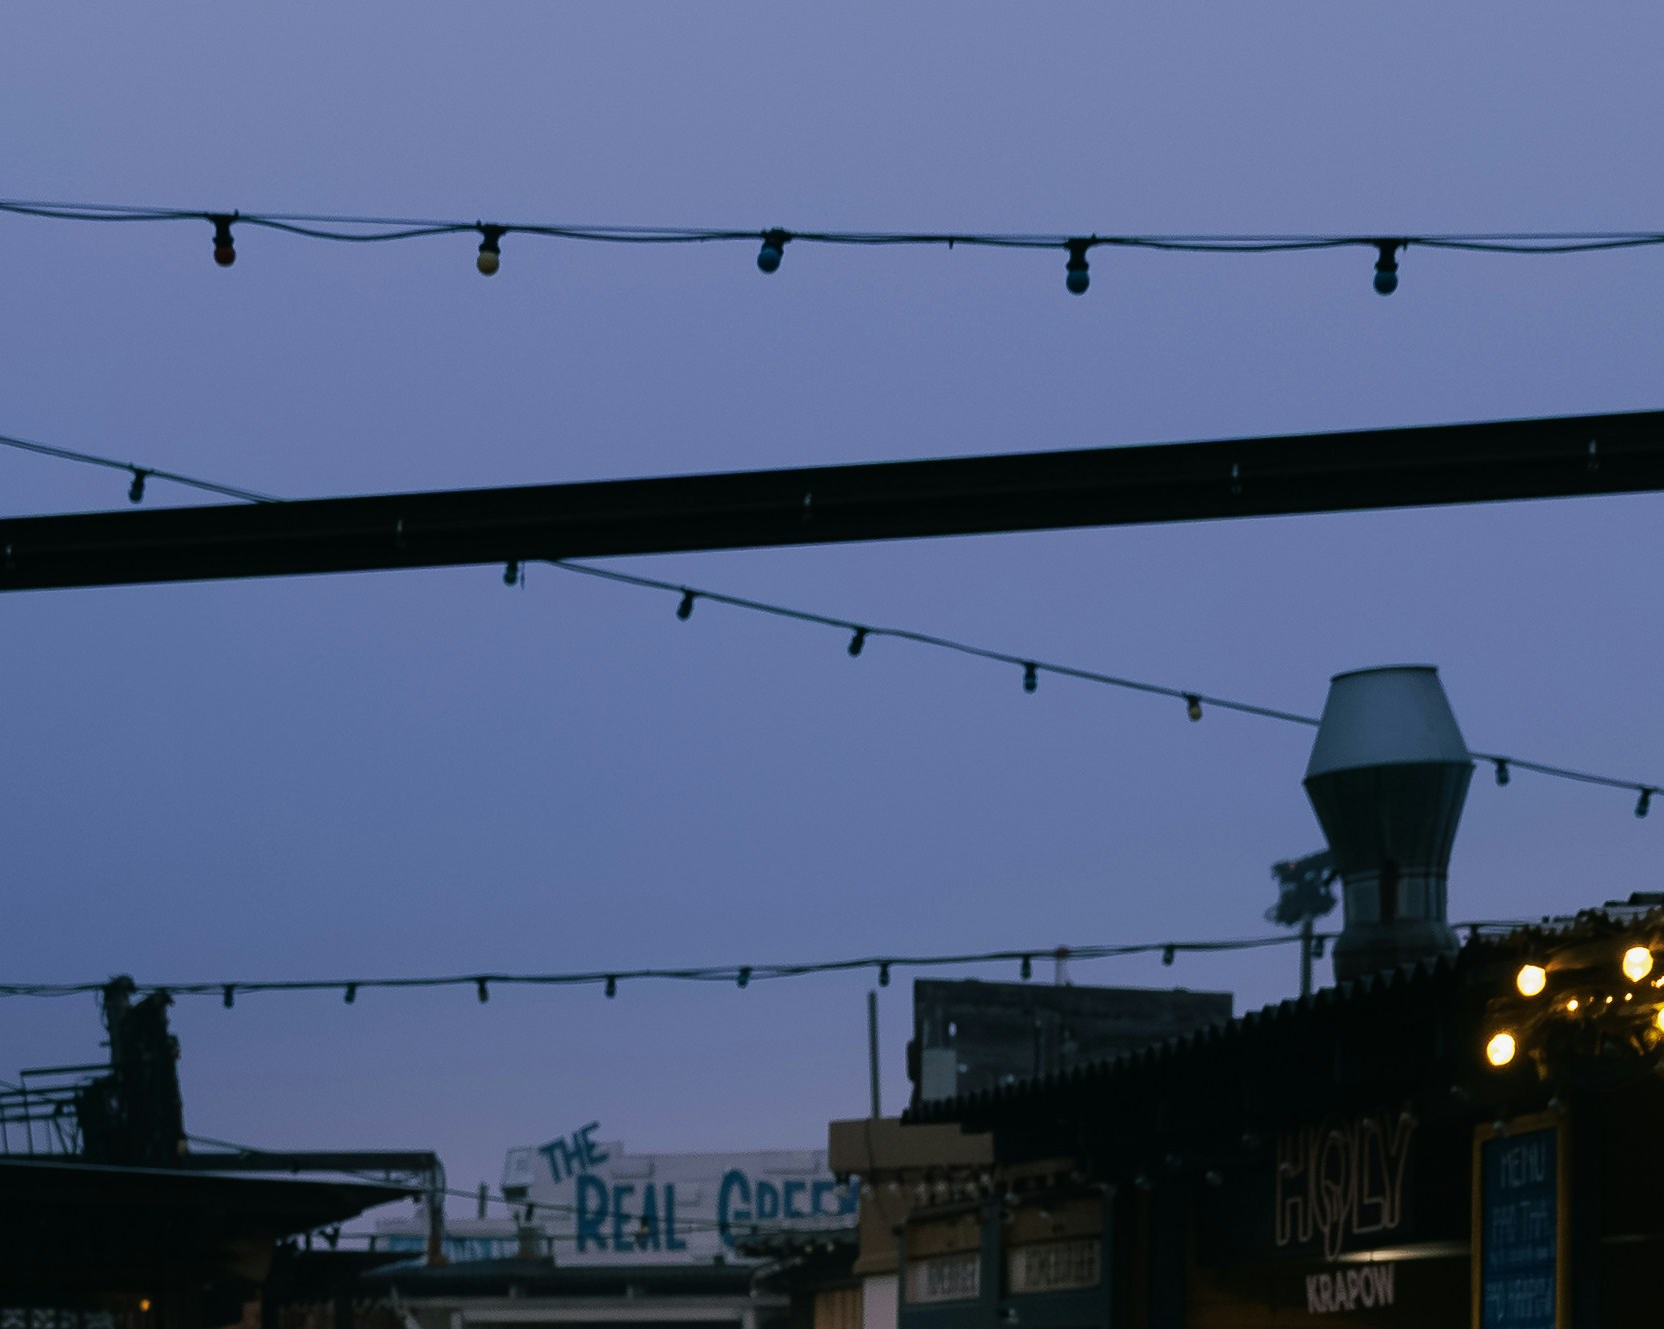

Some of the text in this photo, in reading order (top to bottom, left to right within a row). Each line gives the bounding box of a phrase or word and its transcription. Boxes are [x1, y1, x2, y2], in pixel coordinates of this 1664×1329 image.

[538, 1120, 610, 1184] THE
[576, 1174, 687, 1253] REAL
[1305, 1261, 1396, 1315] KRAPOW
